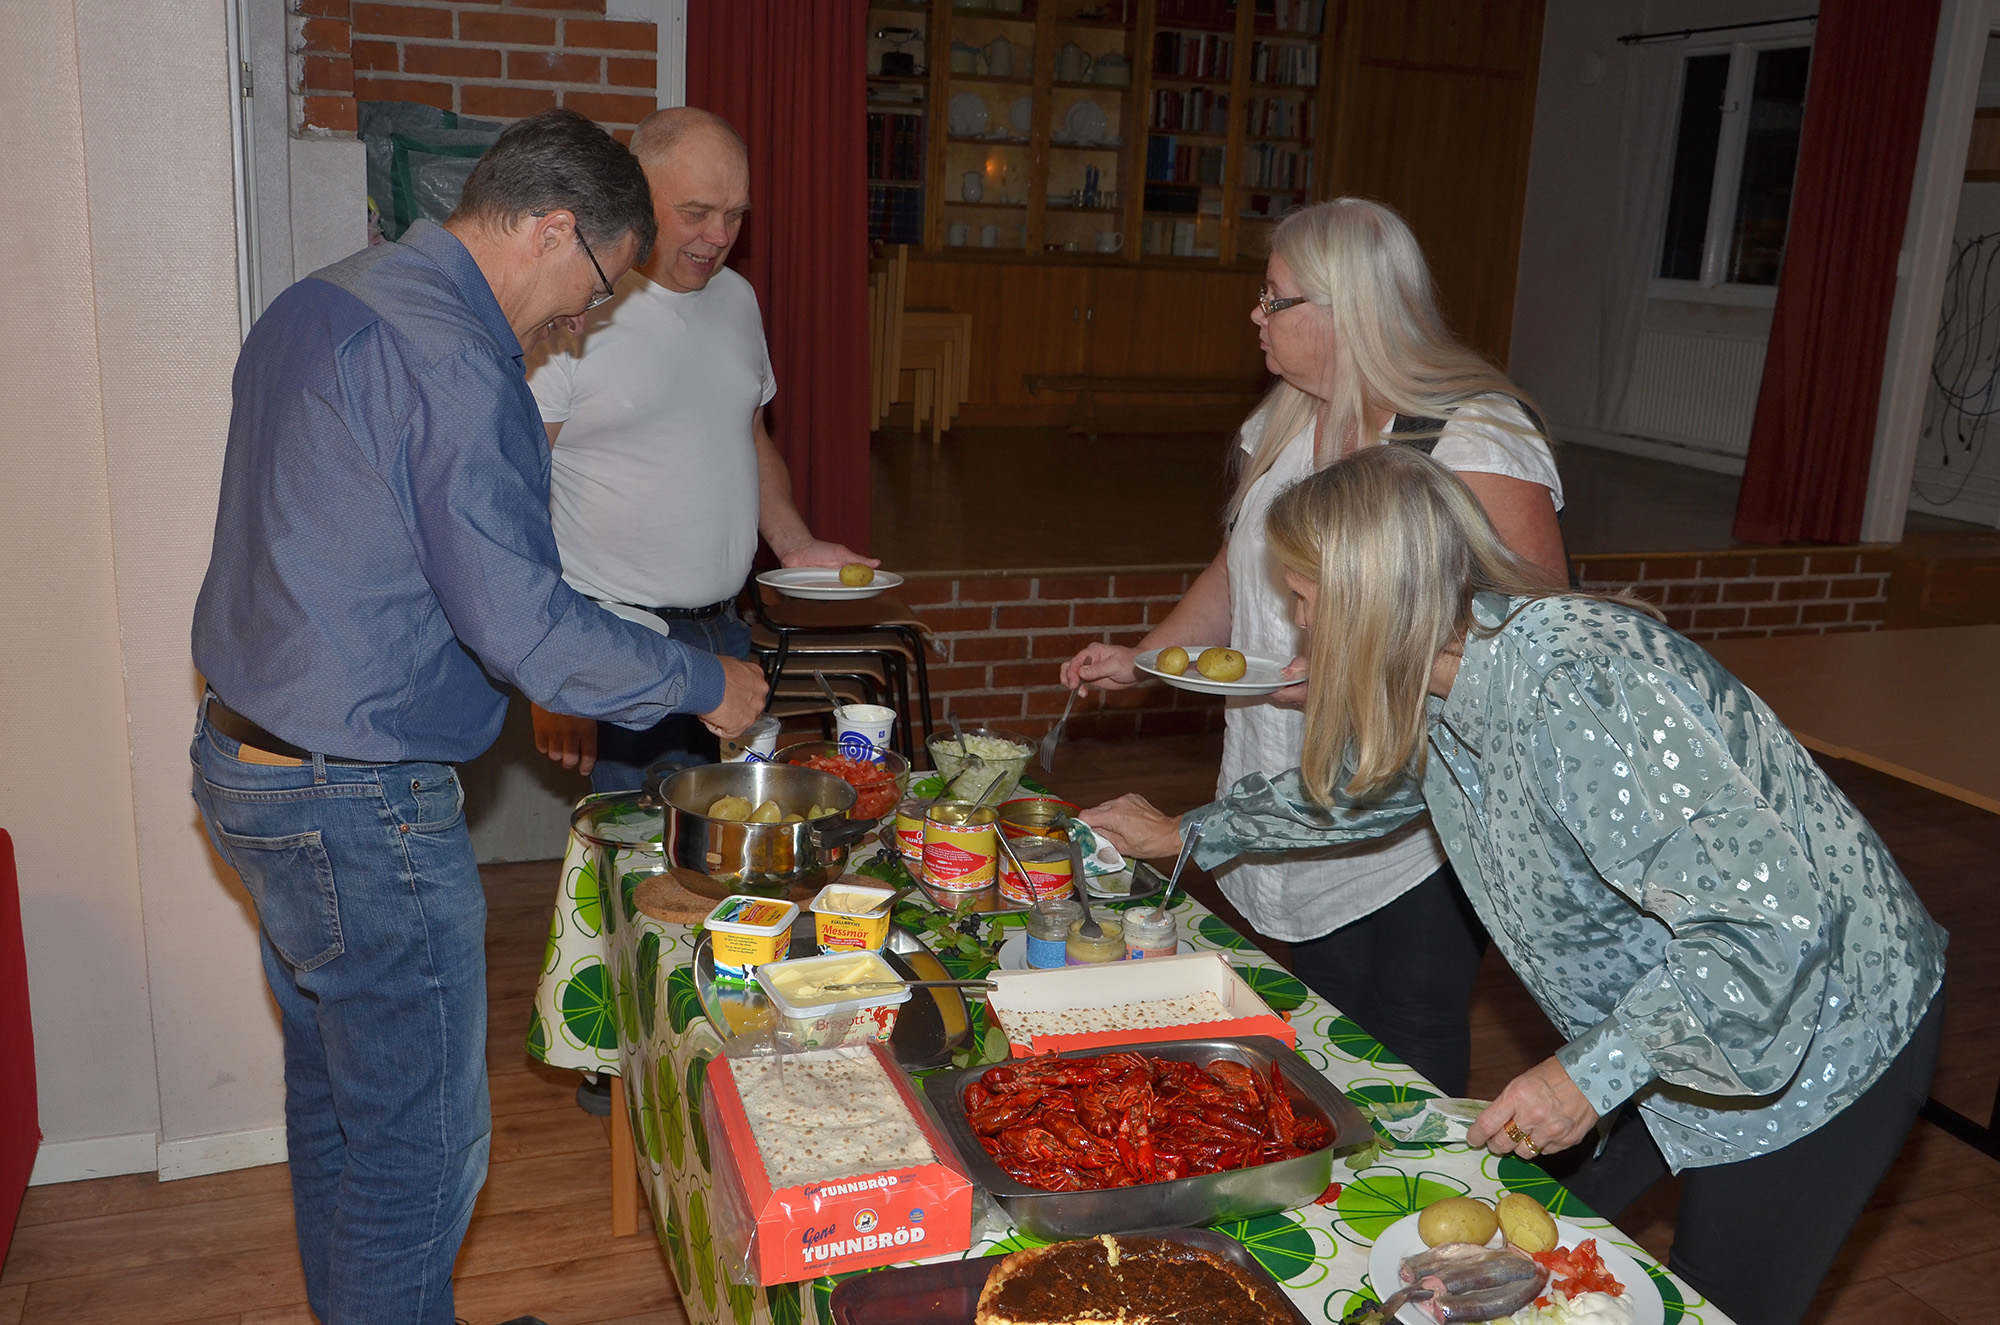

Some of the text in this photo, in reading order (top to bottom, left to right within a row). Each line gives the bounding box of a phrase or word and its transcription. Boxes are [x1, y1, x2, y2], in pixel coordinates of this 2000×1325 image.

[821, 923, 869, 939] Messmör
[815, 1014, 865, 1031] Bregott
[803, 1185, 822, 1199] Gene
[819, 1175, 898, 1198] TUNNBRÖD
[802, 1223, 836, 1252] Gene
[802, 1226, 926, 1263] TUNNBRÖD
